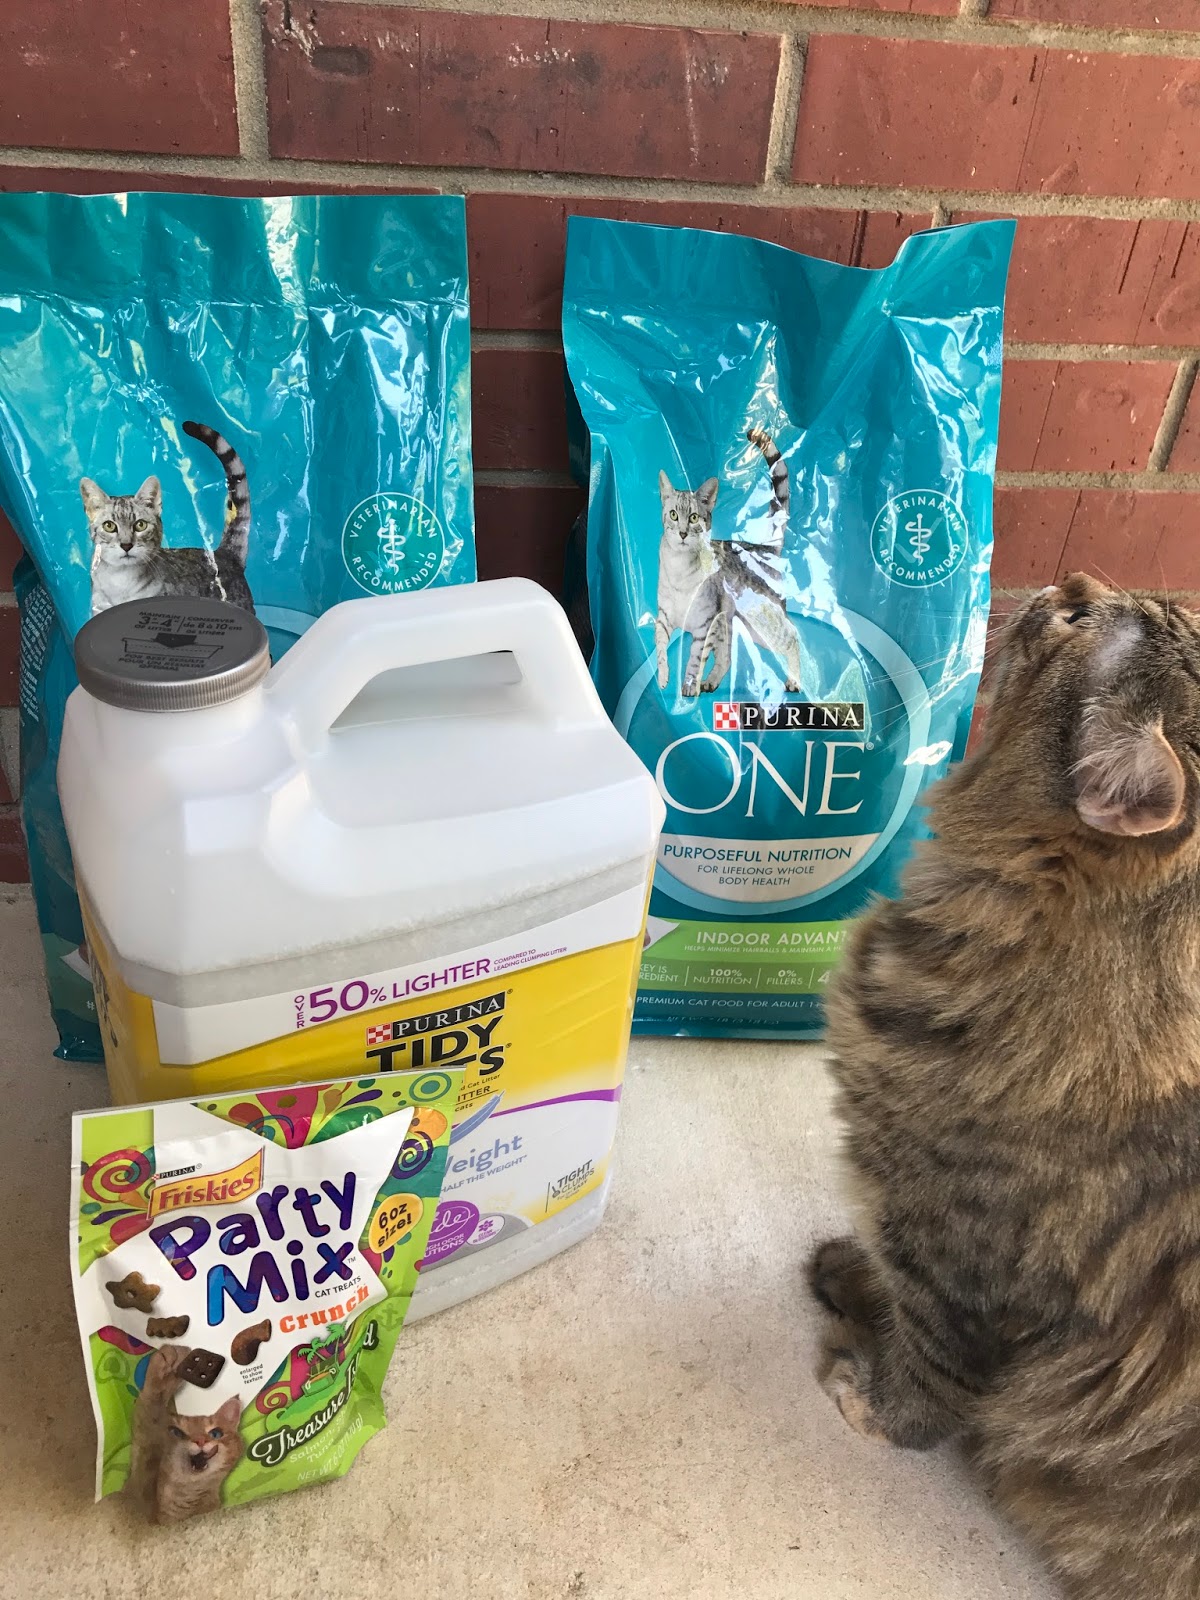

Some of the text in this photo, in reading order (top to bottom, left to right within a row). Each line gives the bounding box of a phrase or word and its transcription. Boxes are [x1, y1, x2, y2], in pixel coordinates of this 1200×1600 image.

[350, 500, 437, 538] VETERINARIAN
[880, 544, 960, 580] RECOMMENDED
[352, 552, 436, 591] RECOMMENDED
[187, 616, 235, 624] CONSERVER
[744, 706, 860, 727] PURINA
[655, 732, 865, 818] ONE
[664, 844, 852, 862] PURPOSEFUL NUTRITION
[697, 864, 815, 876] FOR LIFELONG WHOLE
[718, 876, 790, 886] BODY HEALTH
[696, 930, 848, 946] INDOOR ADVANT
[742, 946, 780, 954] HAIRBALLS
[494, 952, 526, 965] COMPARED
[494, 947, 567, 971] LEADING CLUMPING LITTER
[639, 972, 678, 982] REDIENT
[640, 964, 668, 974] KEY IS
[710, 968, 743, 977] 100%
[778, 969, 797, 978] 0%
[693, 976, 752, 986] NUTRITION
[766, 977, 803, 986] FILLERS
[294, 958, 492, 1029] OVER 50% LIGHTER
[636, 996, 684, 1006] PREMIUM
[688, 998, 709, 1006] CAT
[712, 1000, 744, 1008] FOOD
[747, 1000, 768, 1008] FOR
[773, 1000, 806, 1008] ADULT
[396, 998, 502, 1036] PURINA
[366, 1015, 504, 1072] TIDY
[458, 1086, 490, 1102] ITTER
[454, 1102, 473, 1112] cats
[161, 1167, 194, 1178] PURINA
[466, 1172, 486, 1184] THE
[557, 1158, 592, 1188] TIGHT
[562, 1168, 595, 1193] CLUMPS
[158, 1173, 255, 1211] Friskies
[149, 1170, 357, 1280] Party
[378, 1213, 412, 1247] size!
[442, 1233, 464, 1246] ODOR
[424, 1238, 464, 1258] UTIONS
[206, 1240, 355, 1327] Mix
[315, 1276, 362, 1298] CAT TREATS
[240, 1363, 264, 1375] enlarged
[249, 1370, 262, 1378] show
[244, 1376, 263, 1384] texture
[251, 1394, 344, 1464] Treasure
[306, 1438, 334, 1464] Tuna
[298, 1470, 316, 1481] NET
